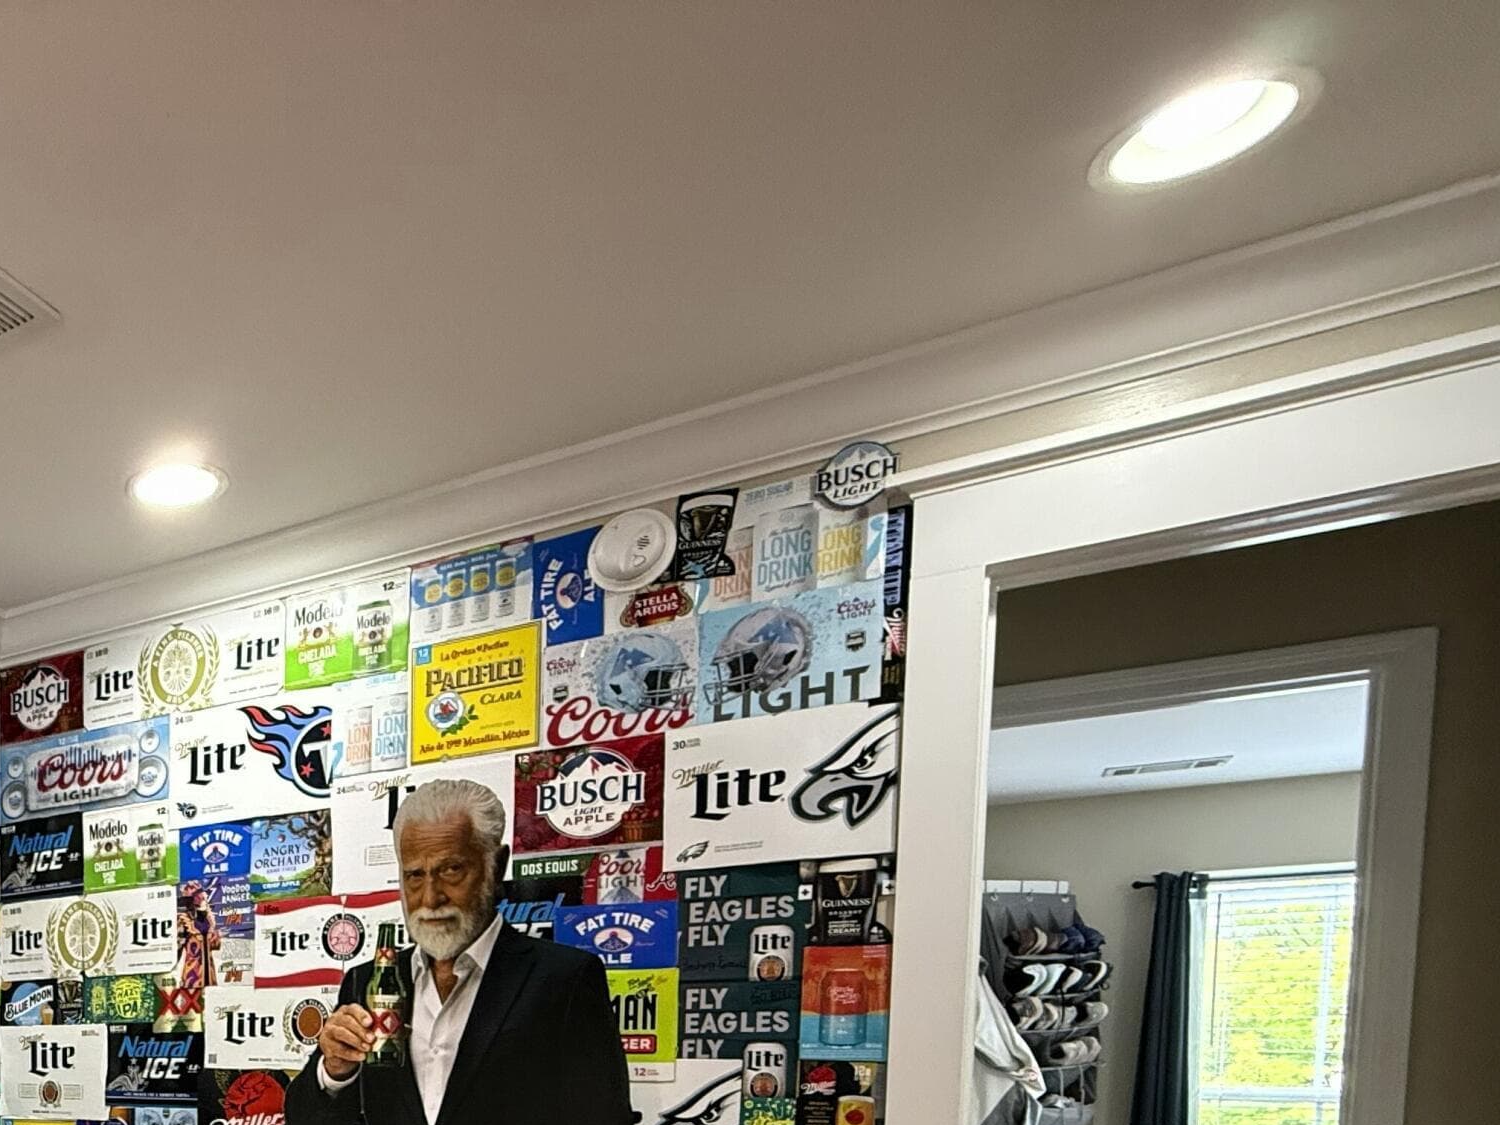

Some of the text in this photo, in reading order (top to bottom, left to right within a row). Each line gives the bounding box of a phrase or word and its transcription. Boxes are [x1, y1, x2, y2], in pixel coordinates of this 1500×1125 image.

[816, 457, 898, 492] BUSCH
[678, 538, 722, 550] GUINNESS
[760, 529, 812, 562] LONG
[757, 555, 814, 585] DRINK
[382, 582, 395, 592] 12
[633, 601, 679, 618] ARTOIS
[634, 591, 678, 610] STELLA
[425, 657, 524, 697] PACIFICO
[479, 690, 523, 706] CLARA
[25, 710, 54, 723] APPLE
[672, 740, 686, 751] 30
[562, 811, 616, 827] APPLE
[263, 844, 301, 856] ANGRY
[30, 848, 67, 873] ICE
[94, 859, 125, 873] CHELADA
[254, 854, 311, 870] ORCHARD
[521, 858, 579, 876] DOS EQUIS
[684, 874, 728, 899] FLY
[688, 895, 795, 923] EAGLES
[821, 899, 871, 909] GUINNESS
[687, 924, 731, 948] FLY
[685, 987, 729, 1010] FLY
[684, 1010, 790, 1034] EAGLES
[142, 1058, 189, 1080] ICE
